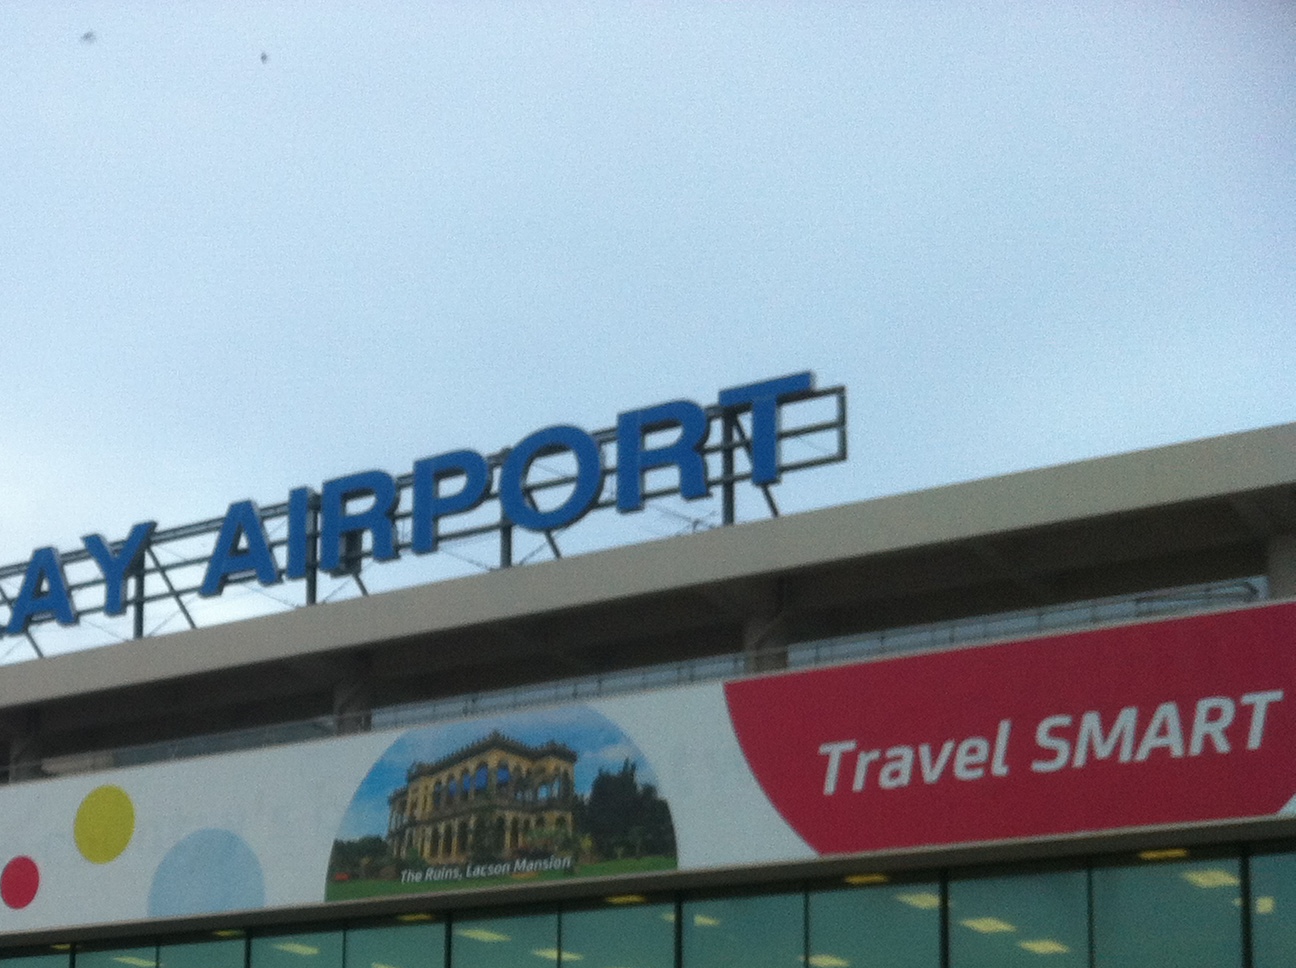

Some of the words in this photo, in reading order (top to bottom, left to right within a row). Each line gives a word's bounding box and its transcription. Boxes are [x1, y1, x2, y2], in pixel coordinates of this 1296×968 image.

[198, 371, 816, 597] AIRPORT
[817, 719, 1012, 796] Travel
[1030, 690, 1284, 773] SMART
[400, 868, 423, 884] The
[424, 866, 463, 881] Ruins,
[466, 862, 510, 878] Lacson
[513, 855, 571, 872] Mansion
